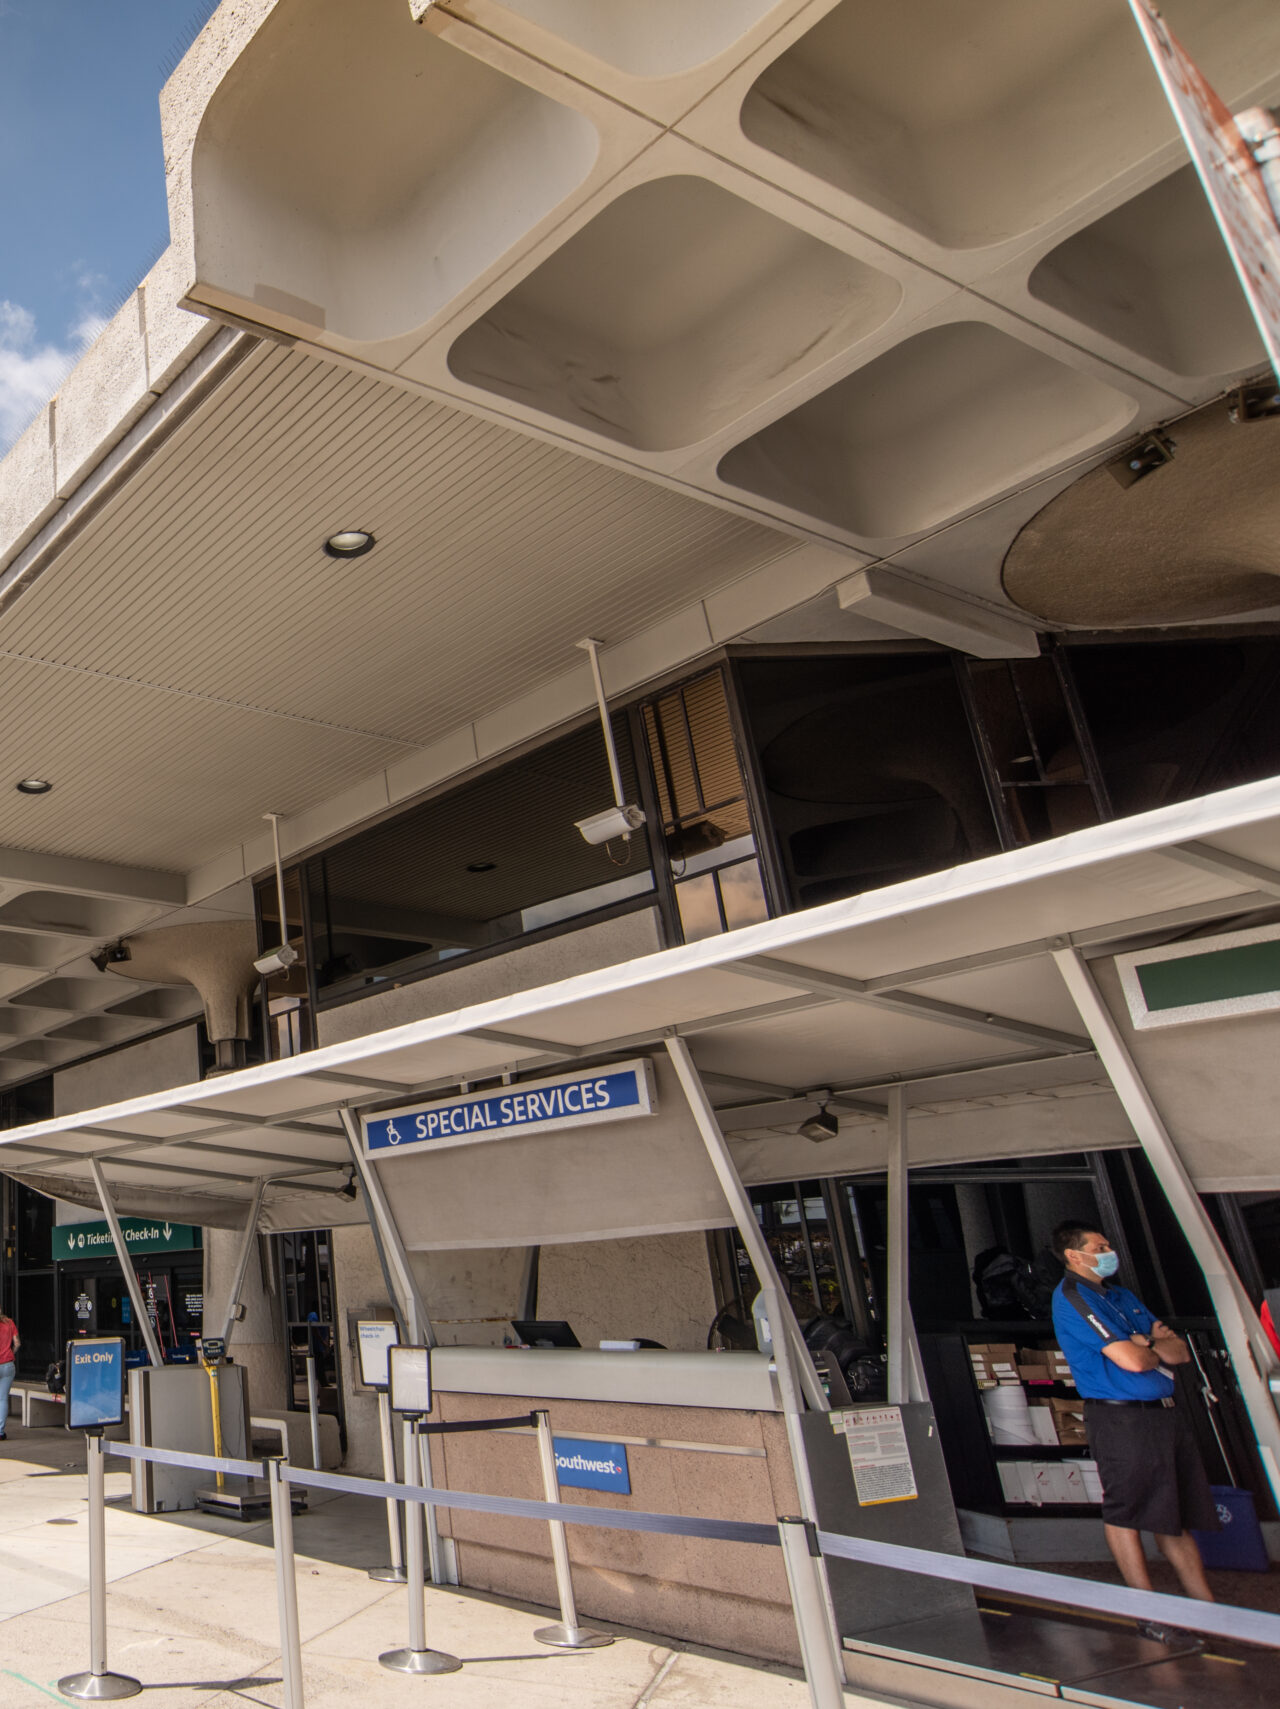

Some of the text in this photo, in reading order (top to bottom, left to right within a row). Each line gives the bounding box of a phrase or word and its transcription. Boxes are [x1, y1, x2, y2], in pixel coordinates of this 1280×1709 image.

[416, 1080, 611, 1138] SPECIAL SERVICES
[125, 1227, 159, 1241] Check-In
[74, 1352, 114, 1365] Exit Only
